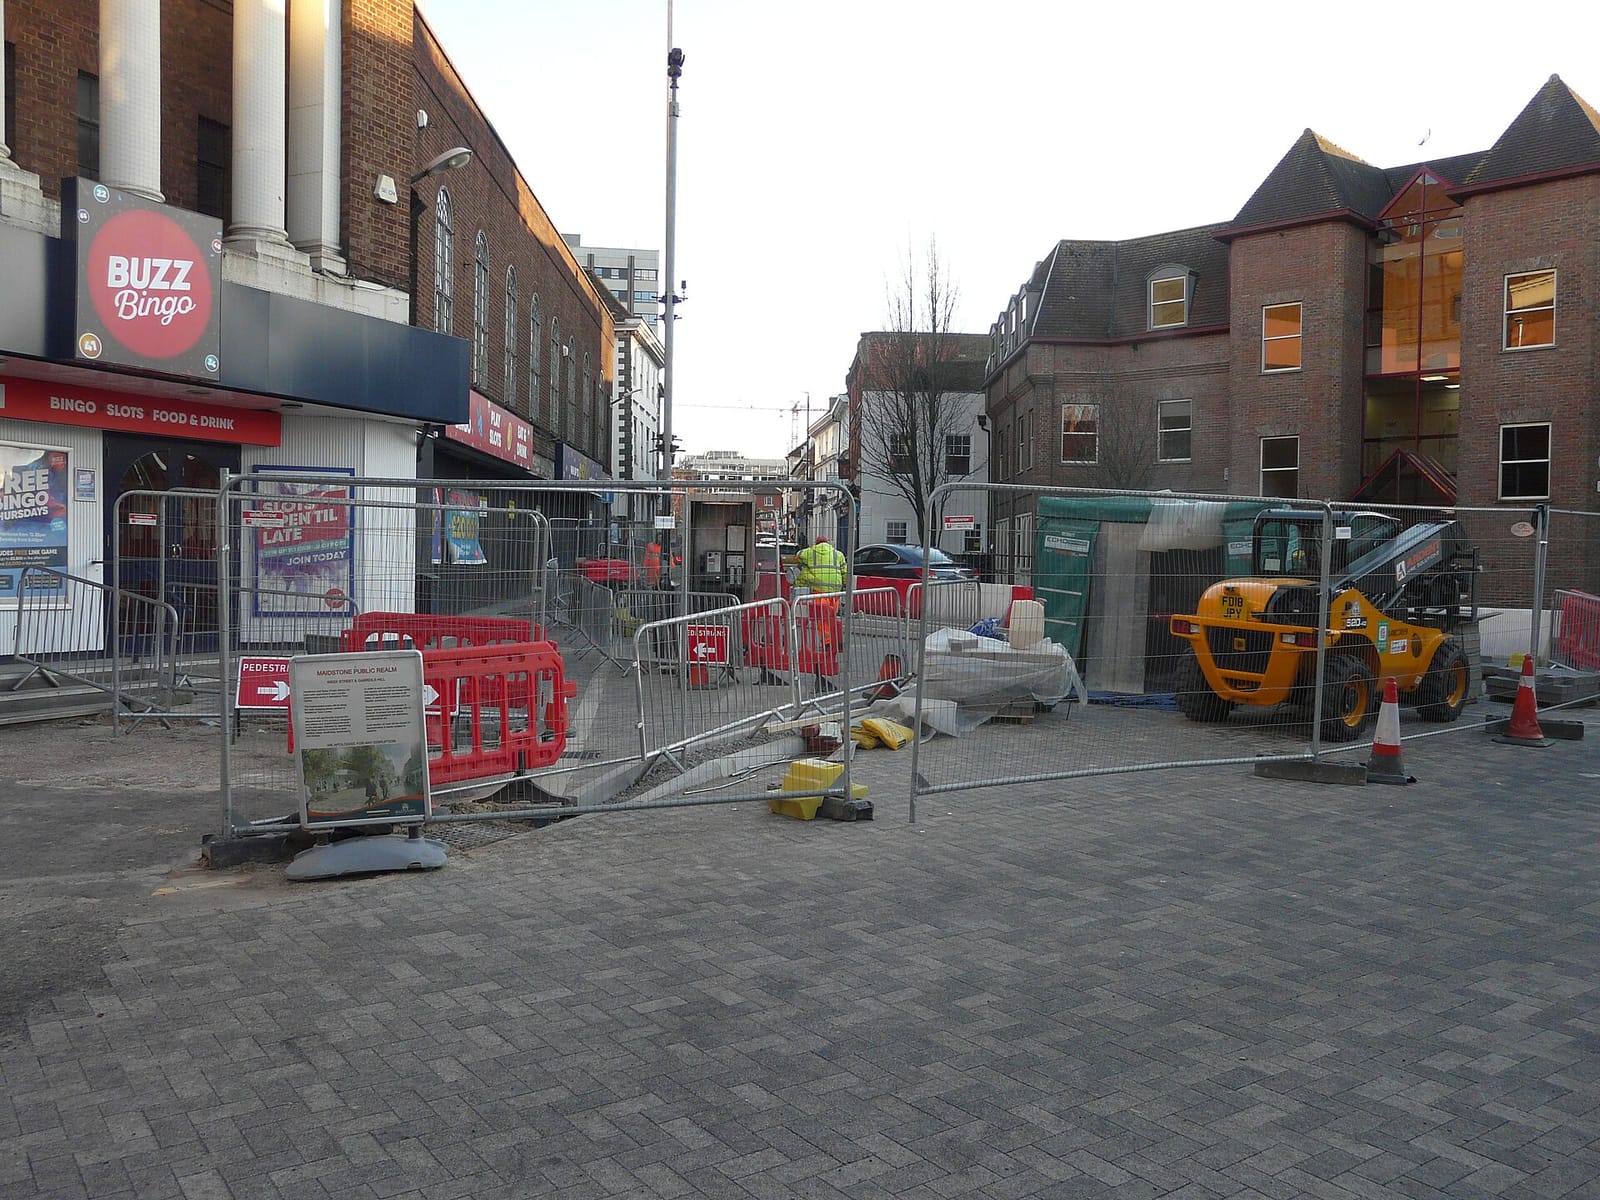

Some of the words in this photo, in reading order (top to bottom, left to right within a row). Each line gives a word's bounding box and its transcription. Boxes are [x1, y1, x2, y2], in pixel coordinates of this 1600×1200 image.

[107, 255, 194, 291] BUZZ
[114, 289, 197, 326] Bingo
[50, 396, 97, 415] BINGO
[106, 403, 145, 420] SLOTS
[153, 409, 187, 425] FOOD
[189, 414, 199, 426] &
[200, 415, 235, 431] DRINK
[4, 468, 49, 494] REE
[0, 506, 49, 521] HURSDAYS
[263, 528, 303, 545] LATE
[286, 555, 311, 566] JOIN
[312, 550, 347, 562] TODAY
[1222, 596, 1244, 608] FD18
[1223, 608, 1242, 619] JPY
[243, 663, 289, 673] PEDESTRI
[316, 668, 353, 677] MAIDSTONE
[353, 667, 376, 675] PUBLIC
[376, 666, 398, 674] REALM
